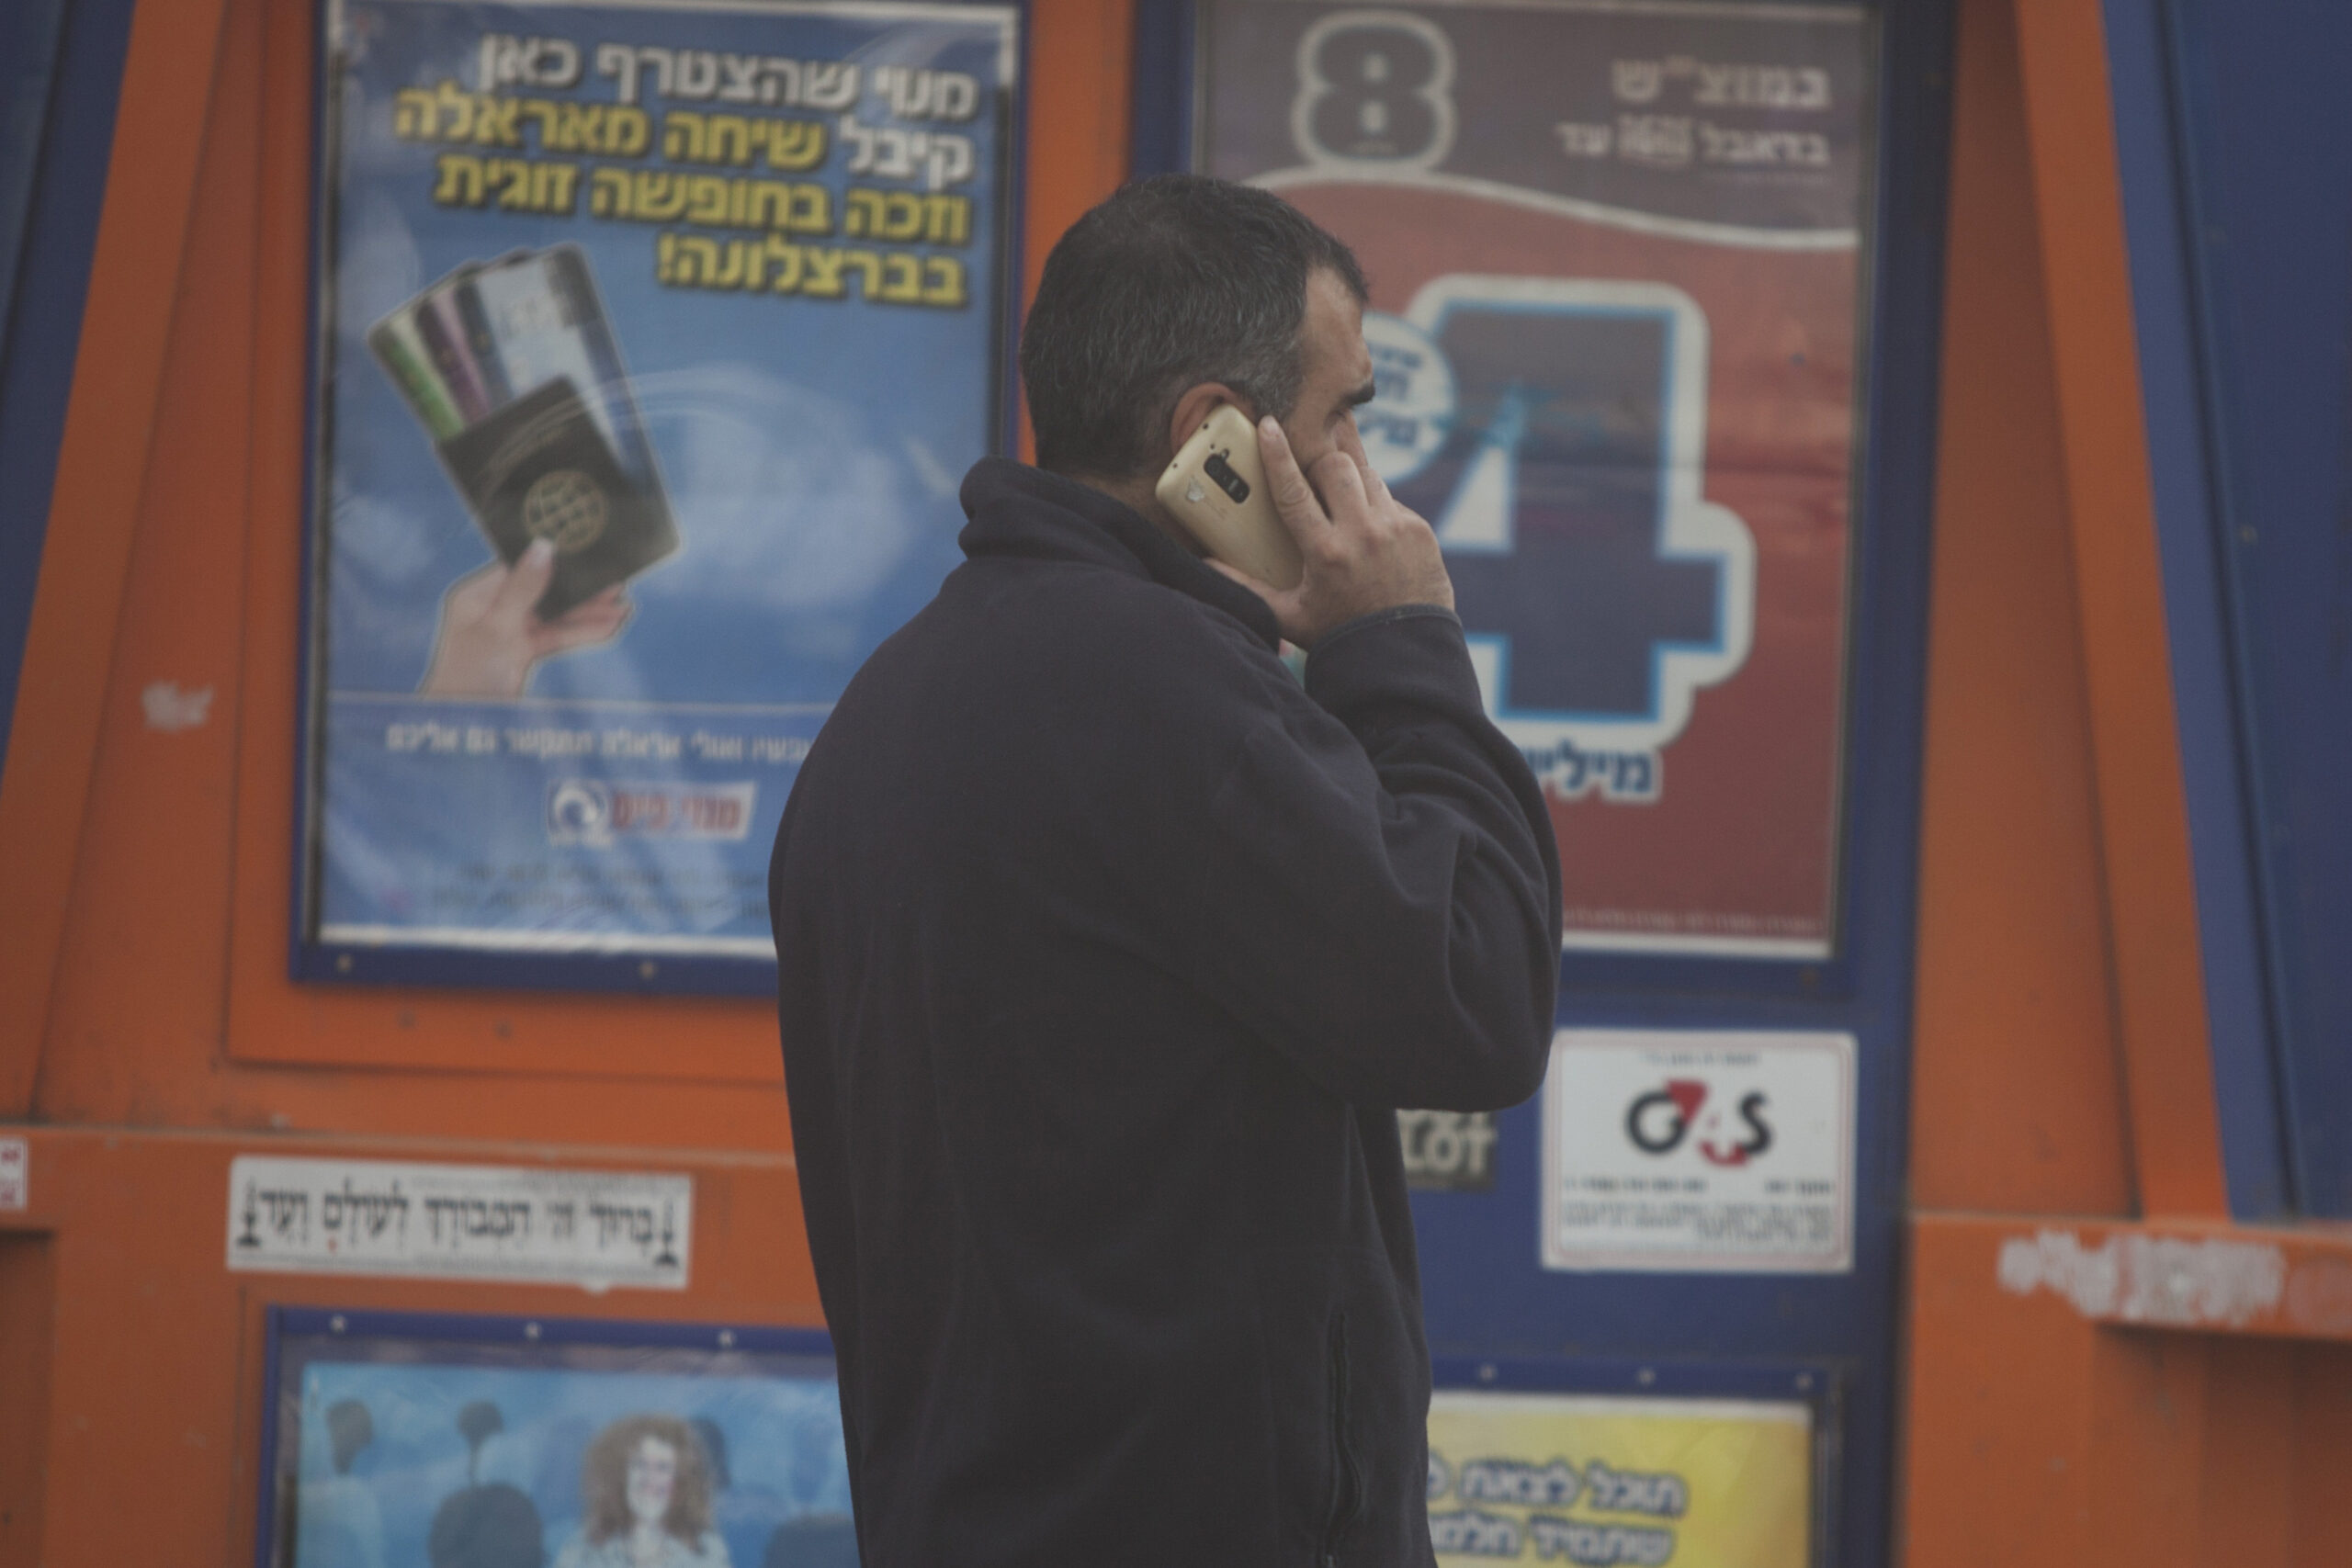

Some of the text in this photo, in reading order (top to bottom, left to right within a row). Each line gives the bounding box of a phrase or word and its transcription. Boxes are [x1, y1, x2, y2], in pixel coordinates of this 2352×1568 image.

[478, 34, 978, 118] מנוי שהצטרף כאן
[1295, 11, 1454, 169] 8
[395, 79, 973, 190] קיבל שיחה מאראלה
[435, 154, 970, 244] וזכה בחופשה זוגית
[658, 233, 964, 305] בברצלונה!
[1392, 299, 1729, 721] 4
